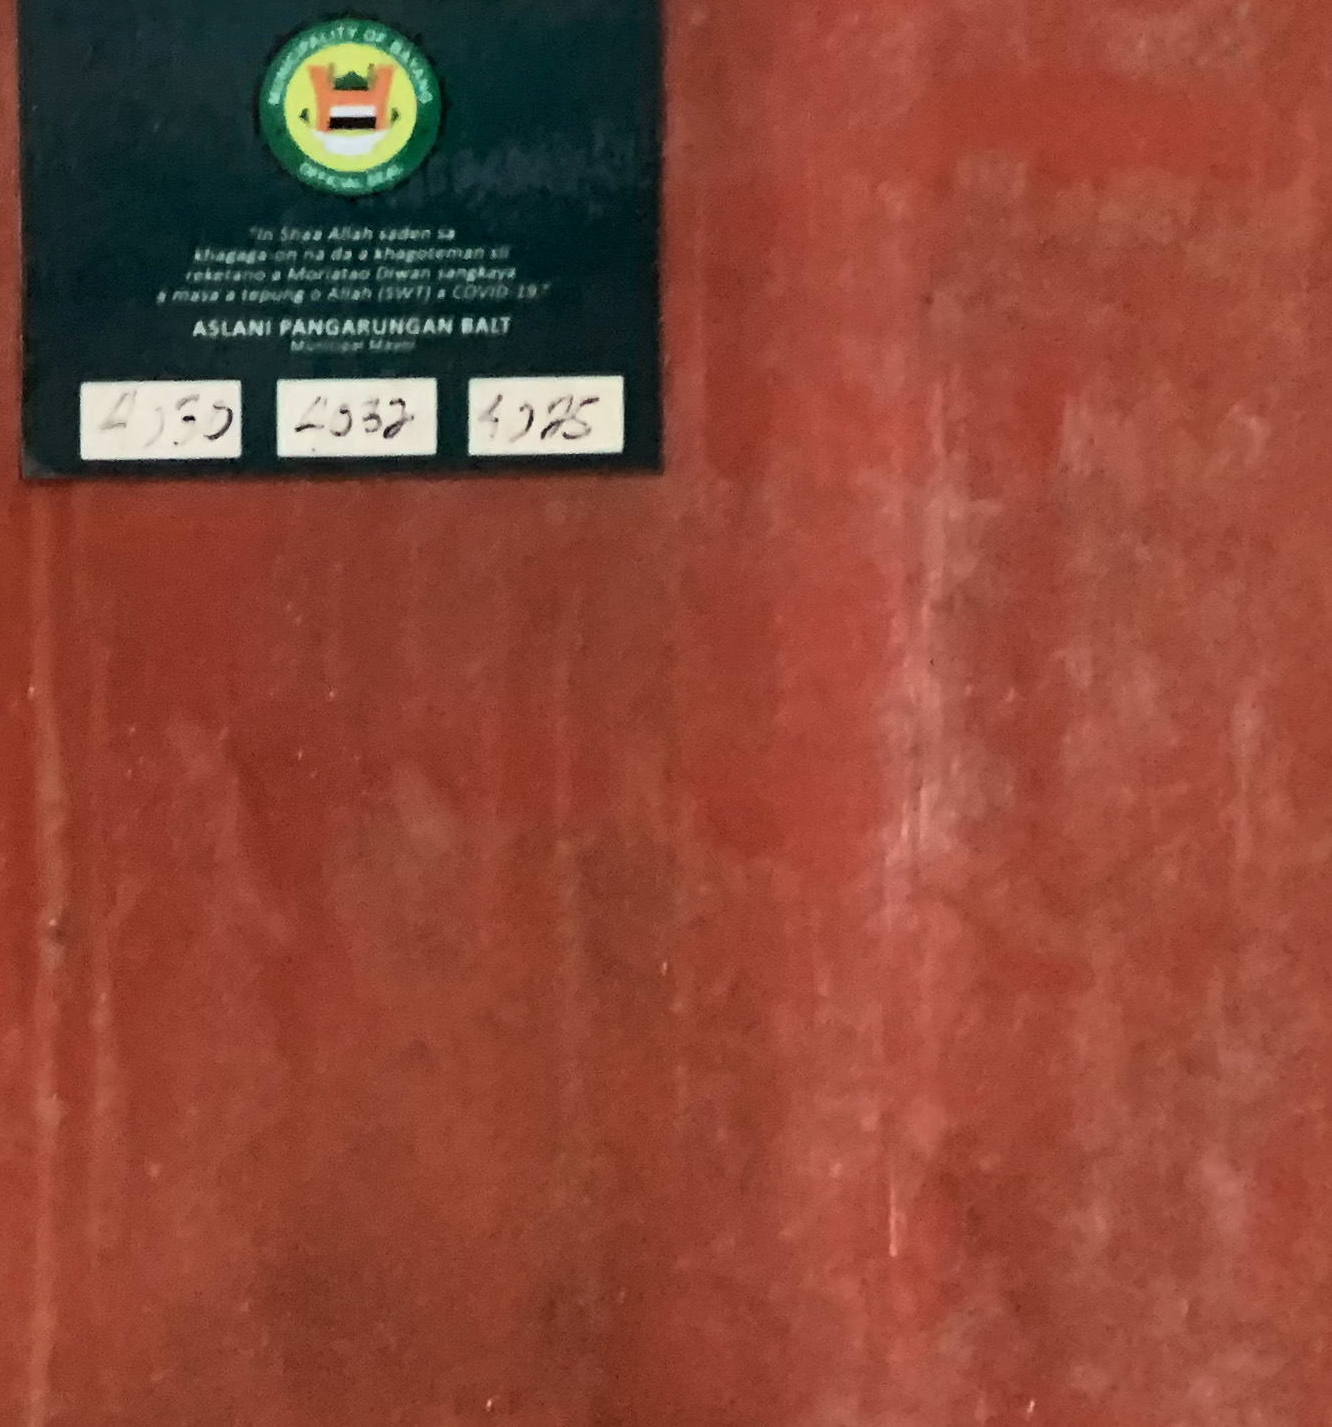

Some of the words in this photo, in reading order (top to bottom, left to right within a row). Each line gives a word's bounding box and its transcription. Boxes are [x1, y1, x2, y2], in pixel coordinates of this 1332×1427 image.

[363, 28, 387, 43] OF
[328, 226, 373, 241] Allah
[327, 286, 373, 302] Allah
[377, 285, 432, 302] (SWT)
[192, 318, 272, 337] ASLANI
[279, 317, 453, 337] PANGARUNGAN
